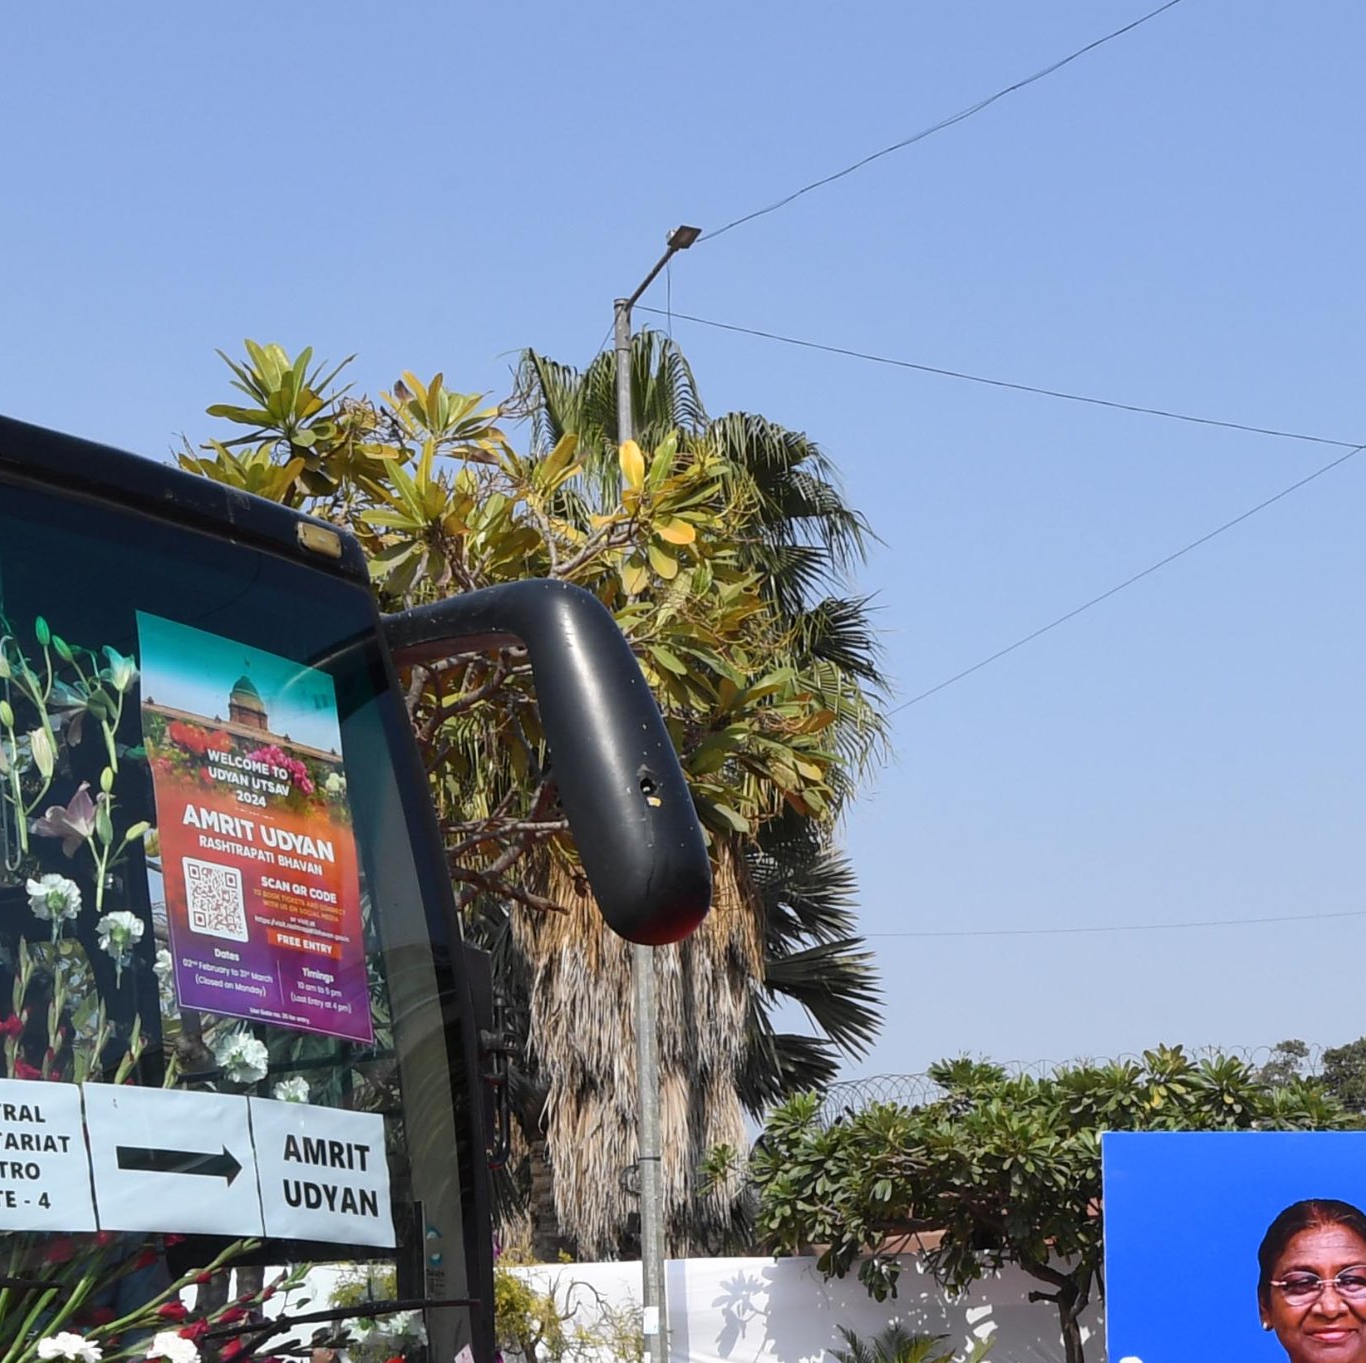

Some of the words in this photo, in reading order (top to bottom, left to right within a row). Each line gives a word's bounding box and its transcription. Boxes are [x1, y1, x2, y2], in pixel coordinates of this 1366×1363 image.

[207, 748, 268, 773] WELCOME
[271, 765, 289, 780] TO
[208, 766, 250, 787] UDYAN
[253, 777, 290, 797] UTSAV
[237, 790, 267, 808] 2024
[183, 804, 255, 841] AMRIT
[260, 825, 334, 862] UDYAN
[199, 834, 274, 864] RASHTRAPATI
[278, 854, 323, 876] BHAVAN
[261, 876, 290, 893] SCAN
[292, 884, 307, 897] QR
[310, 888, 337, 904] CODE
[213, 948, 240, 962] Dates
[277, 933, 301, 948] FREE
[303, 939, 333, 954] ENTRY
[195, 973, 223, 988] (Closed
[225, 980, 233, 989] on
[235, 981, 267, 997] Monday)
[199, 962, 230, 976] February
[251, 972, 273, 984] March
[301, 966, 335, 984] Timings
[283, 1134, 371, 1172] AMRIT
[37, 1192, 51, 1210] 4
[283, 1178, 379, 1218] UDYAN
